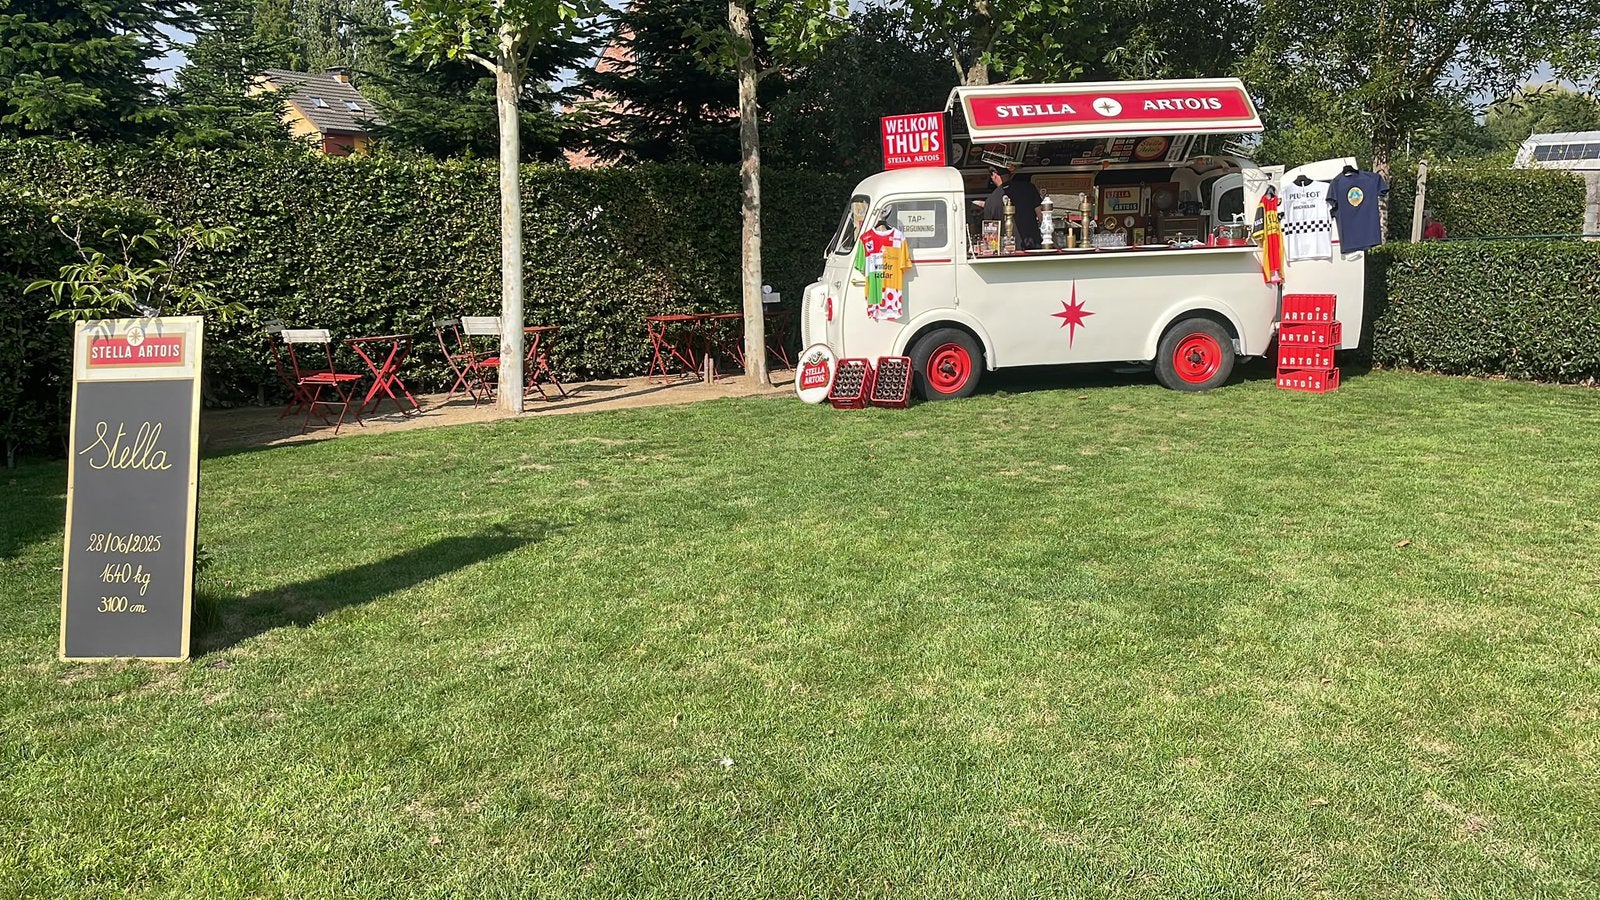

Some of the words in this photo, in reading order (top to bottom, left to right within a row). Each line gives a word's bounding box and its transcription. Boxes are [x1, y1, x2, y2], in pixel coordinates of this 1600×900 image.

[997, 104, 1076, 118] STELLA
[1143, 97, 1222, 111] ARTOIS
[885, 116, 938, 133] WELKOM
[887, 156, 911, 164] STELLA
[914, 154, 939, 162] ARTOIS
[908, 215, 925, 223] TAP-
[91, 344, 132, 359] STELLA
[138, 344, 180, 357] ARTOIS
[804, 374, 825, 384] ARTOIS
[805, 366, 825, 376] STELLA
[79, 421, 172, 470] Stella
[86, 532, 162, 554] 28/06/2025
[100, 563, 132, 583] 1640
[133, 564, 151, 596] kg
[97, 596, 128, 613] 3100
[129, 604, 148, 613] cm
